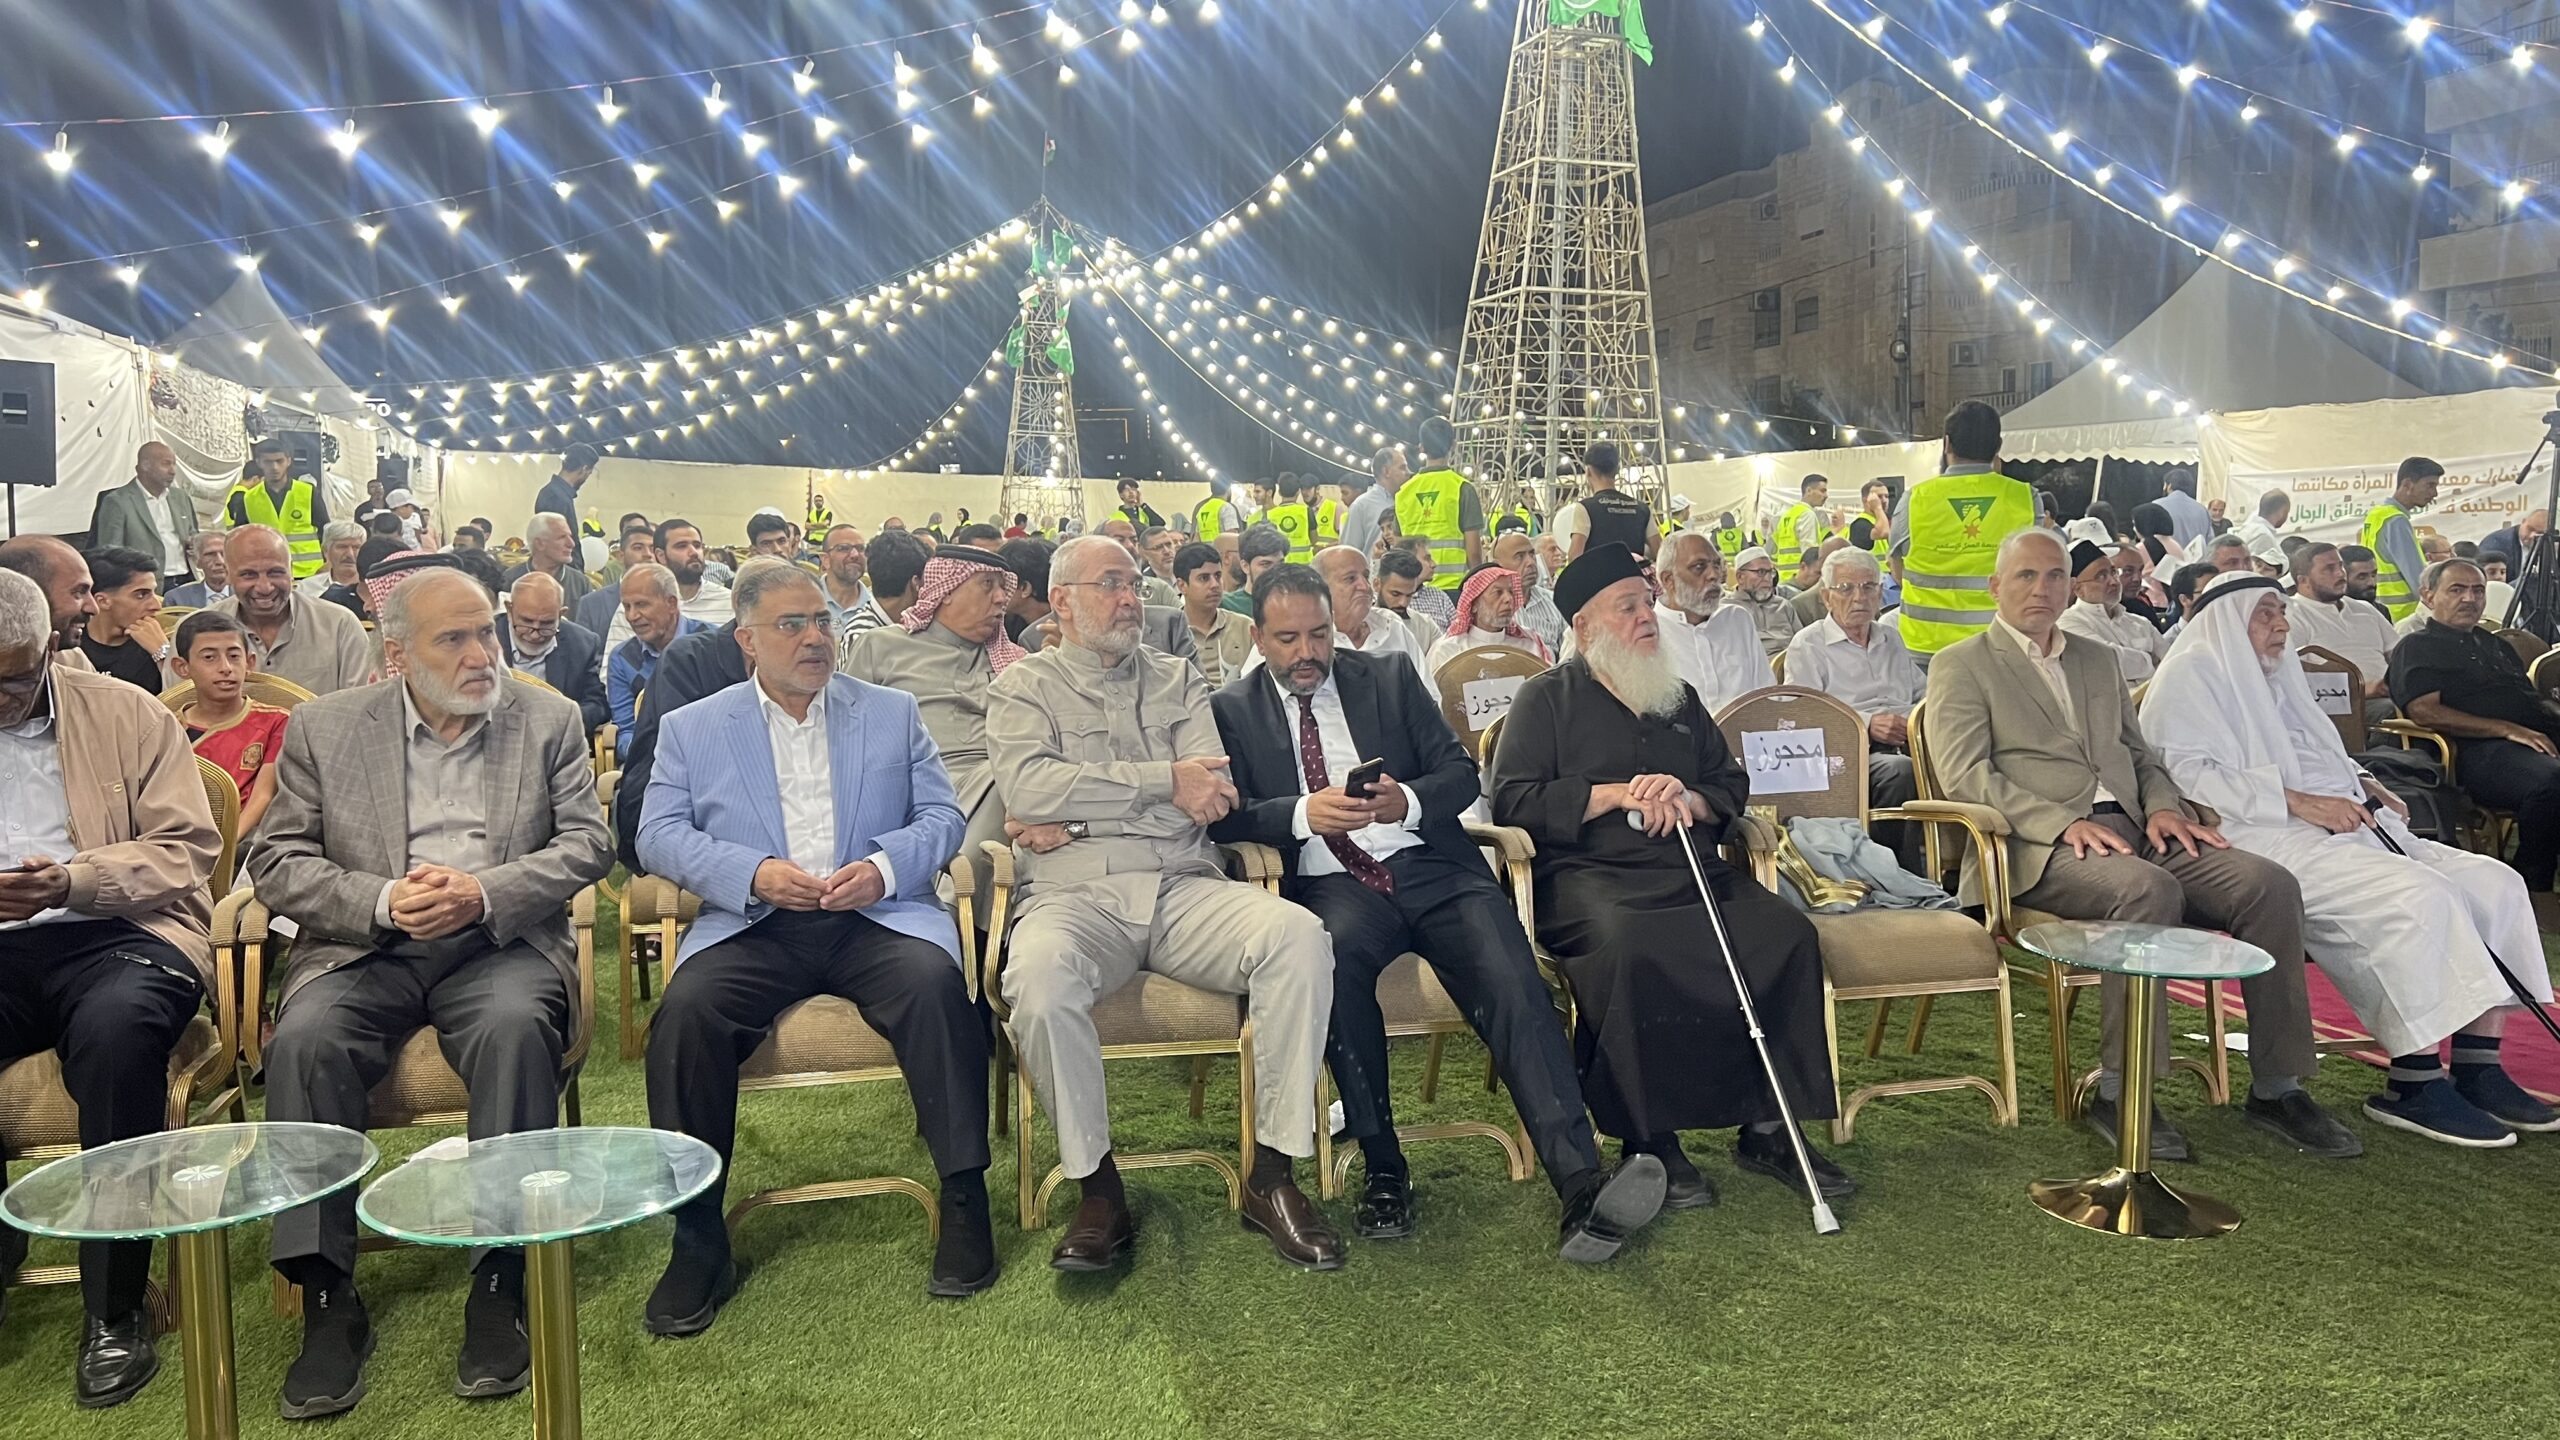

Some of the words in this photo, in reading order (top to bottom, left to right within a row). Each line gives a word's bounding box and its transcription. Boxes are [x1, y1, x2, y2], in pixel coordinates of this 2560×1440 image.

[2292, 475, 2349, 492] مكانتها
[2353, 469, 2393, 494] المرأة
[2290, 503, 2326, 523] الرجال
[2460, 495, 2528, 517] الوطنية
[1470, 695, 1513, 715] حجوز
[2314, 688, 2347, 702] محجو
[1755, 736, 1822, 772] محجوز
[319, 1289, 328, 1309] FILA
